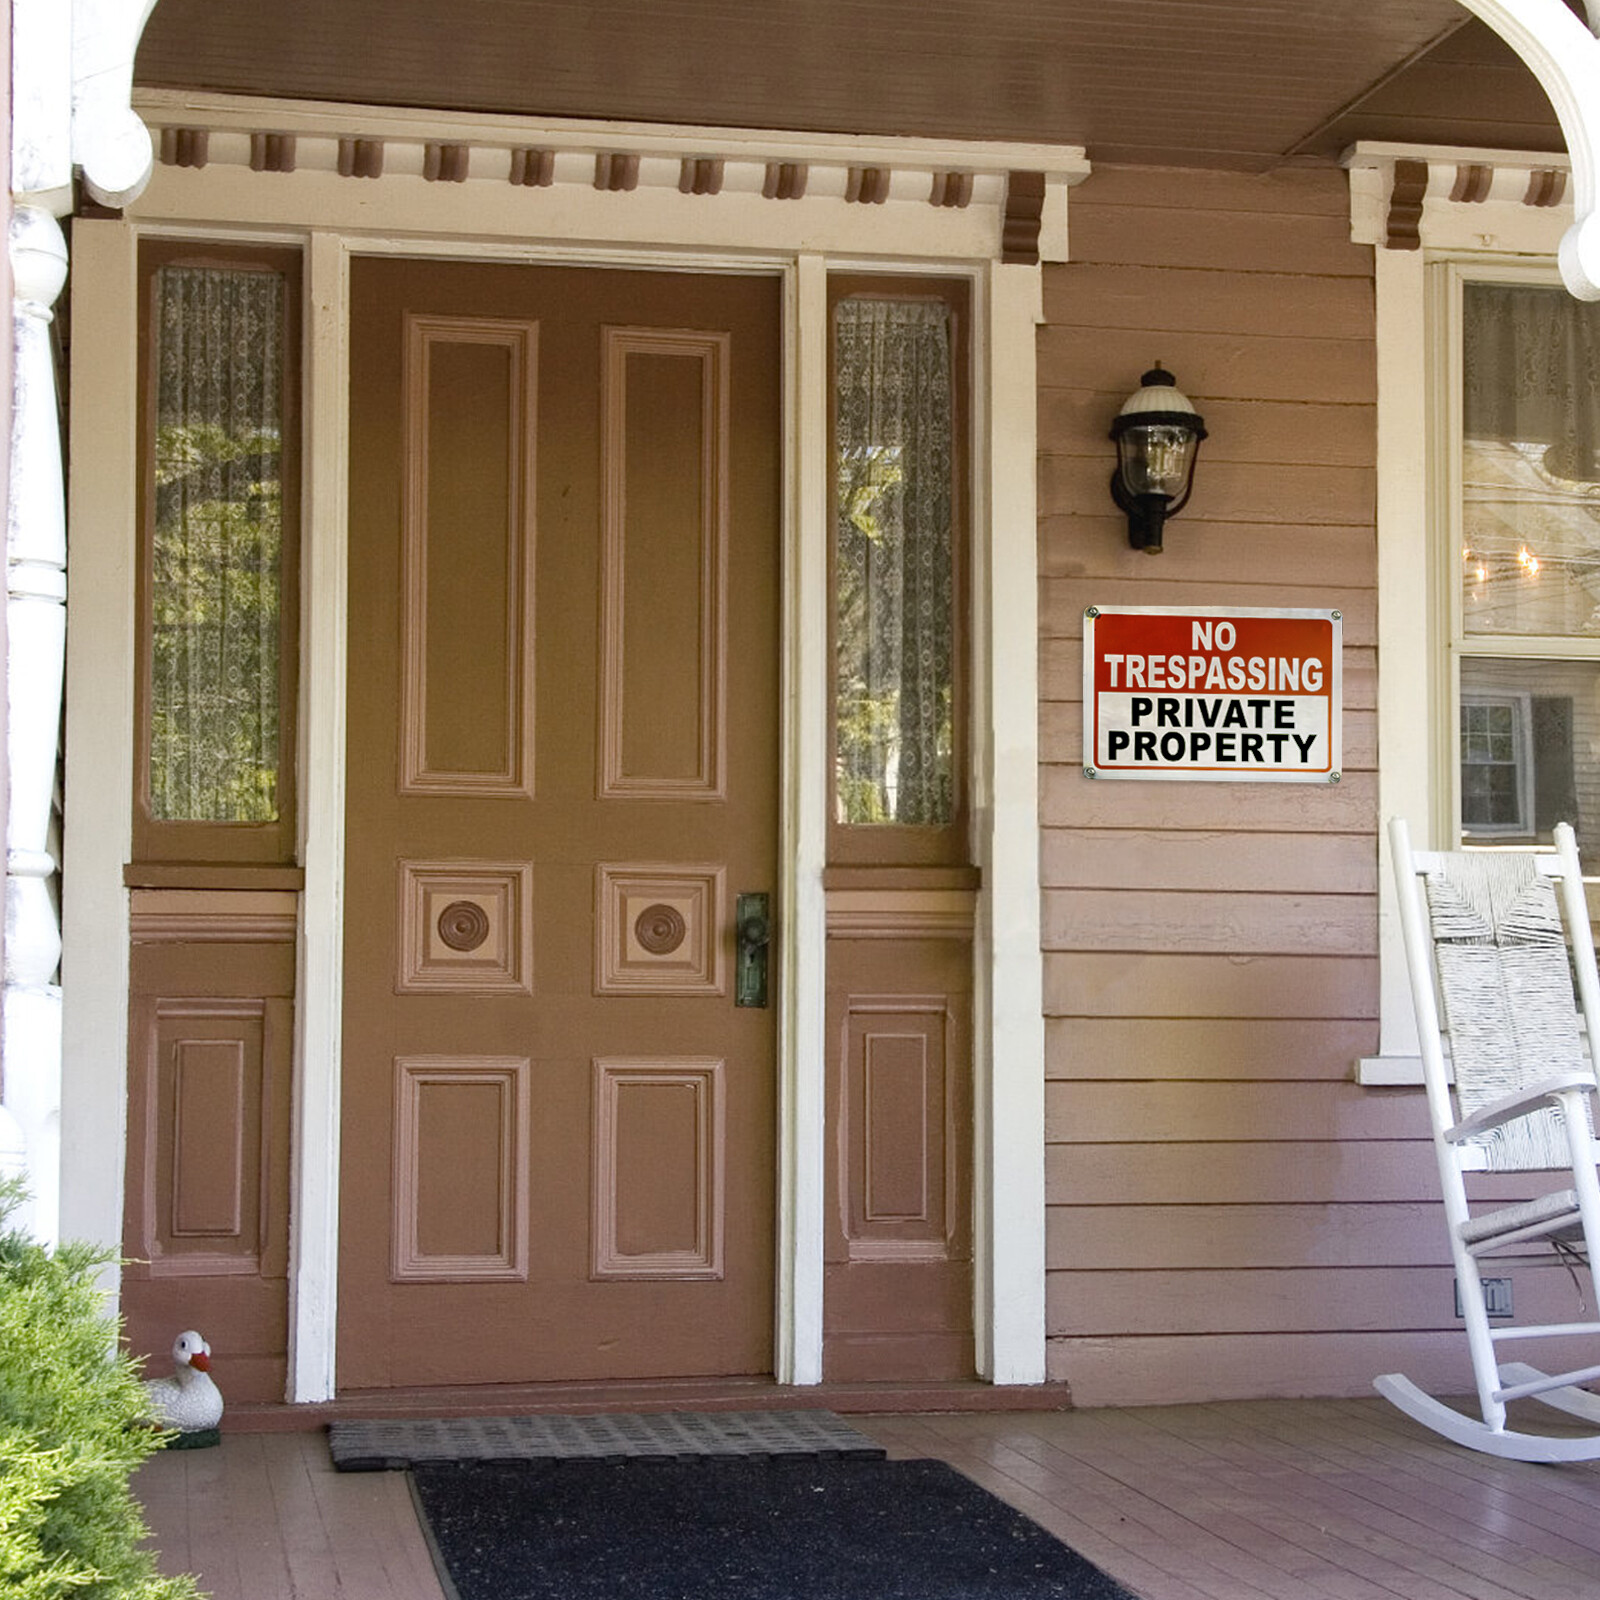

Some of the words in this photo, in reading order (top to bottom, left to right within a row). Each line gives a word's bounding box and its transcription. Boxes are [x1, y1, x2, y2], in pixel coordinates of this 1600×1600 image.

[1192, 621, 1236, 651] NO
[1104, 654, 1323, 692] TRESPASSING
[1132, 697, 1295, 728] PRIVATE
[1108, 731, 1317, 763] PROPERTY
